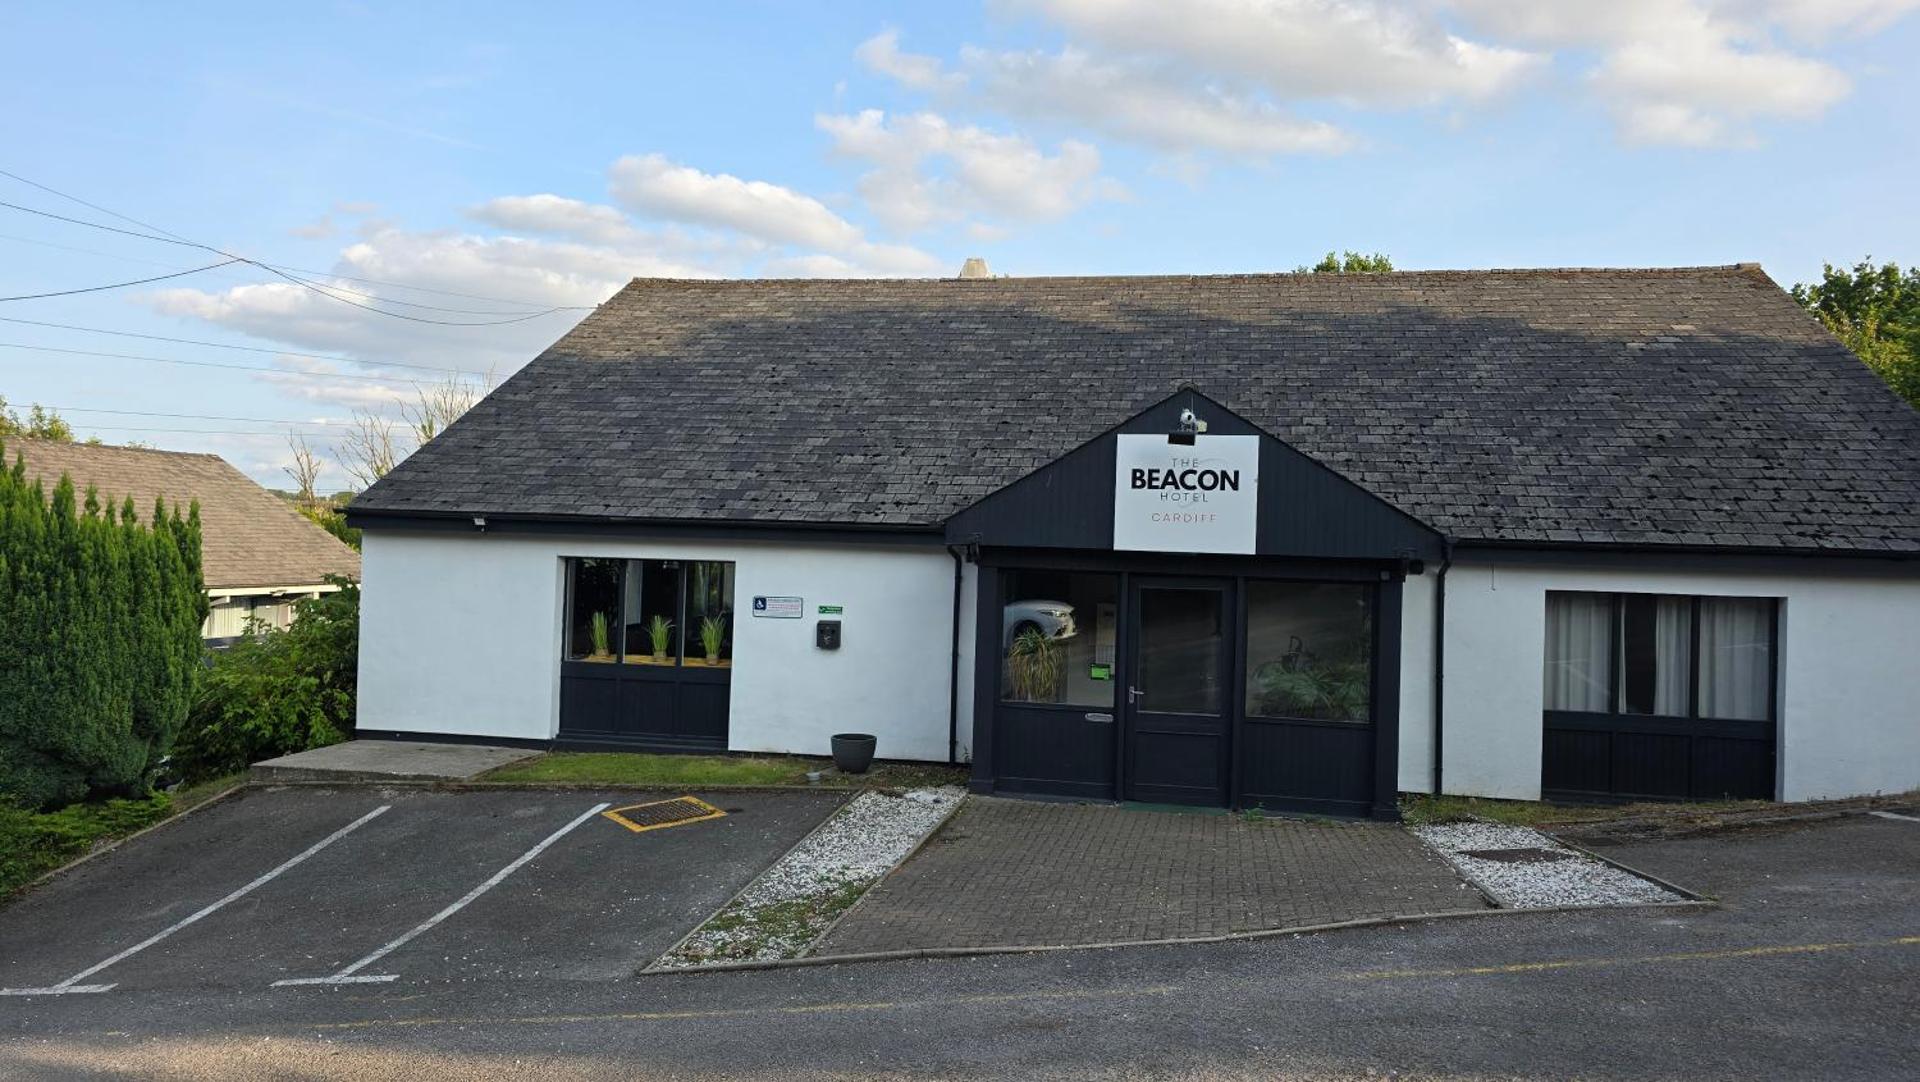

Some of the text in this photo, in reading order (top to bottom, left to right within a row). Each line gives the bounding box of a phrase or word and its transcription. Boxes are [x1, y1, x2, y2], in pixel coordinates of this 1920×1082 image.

[1172, 458, 1200, 468] THE
[1131, 468, 1240, 491] BEACON
[1160, 492, 1208, 503] HOTEL
[1151, 512, 1217, 523] CARDIFF
